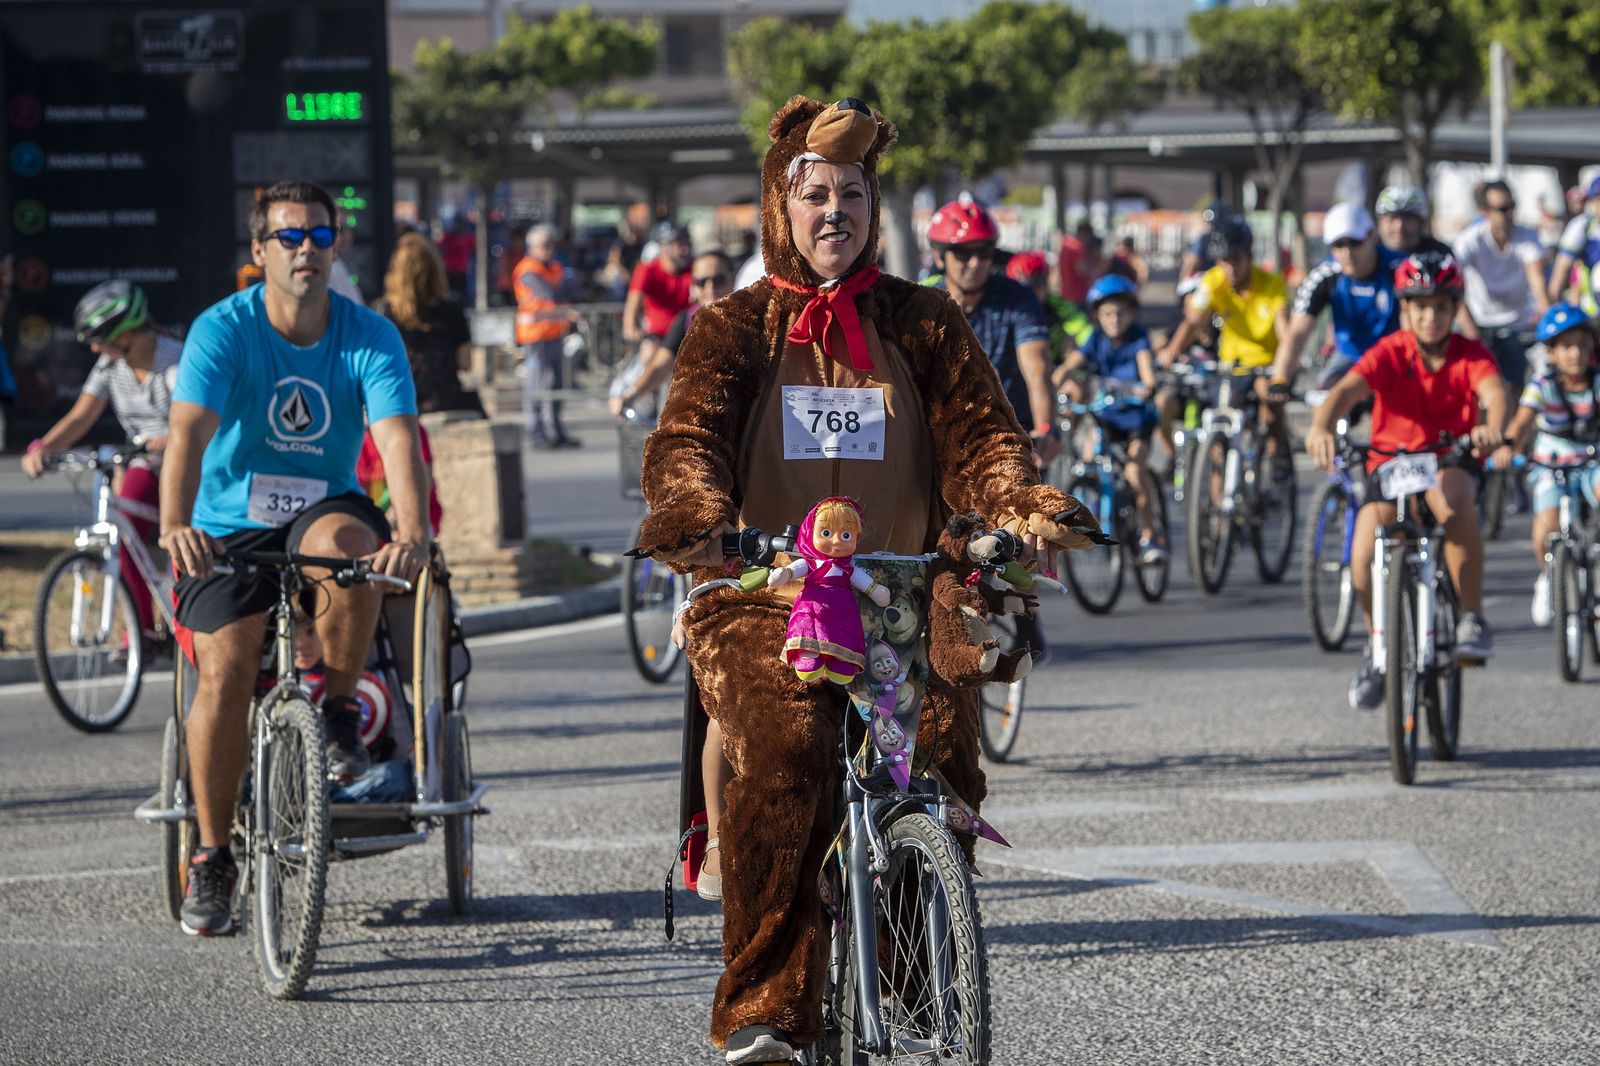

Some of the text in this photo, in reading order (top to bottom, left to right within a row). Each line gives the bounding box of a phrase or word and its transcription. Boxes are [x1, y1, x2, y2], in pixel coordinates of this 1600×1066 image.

[807, 409, 861, 434] 768
[265, 437, 324, 456] VOLCOM
[267, 493, 306, 513] 332
